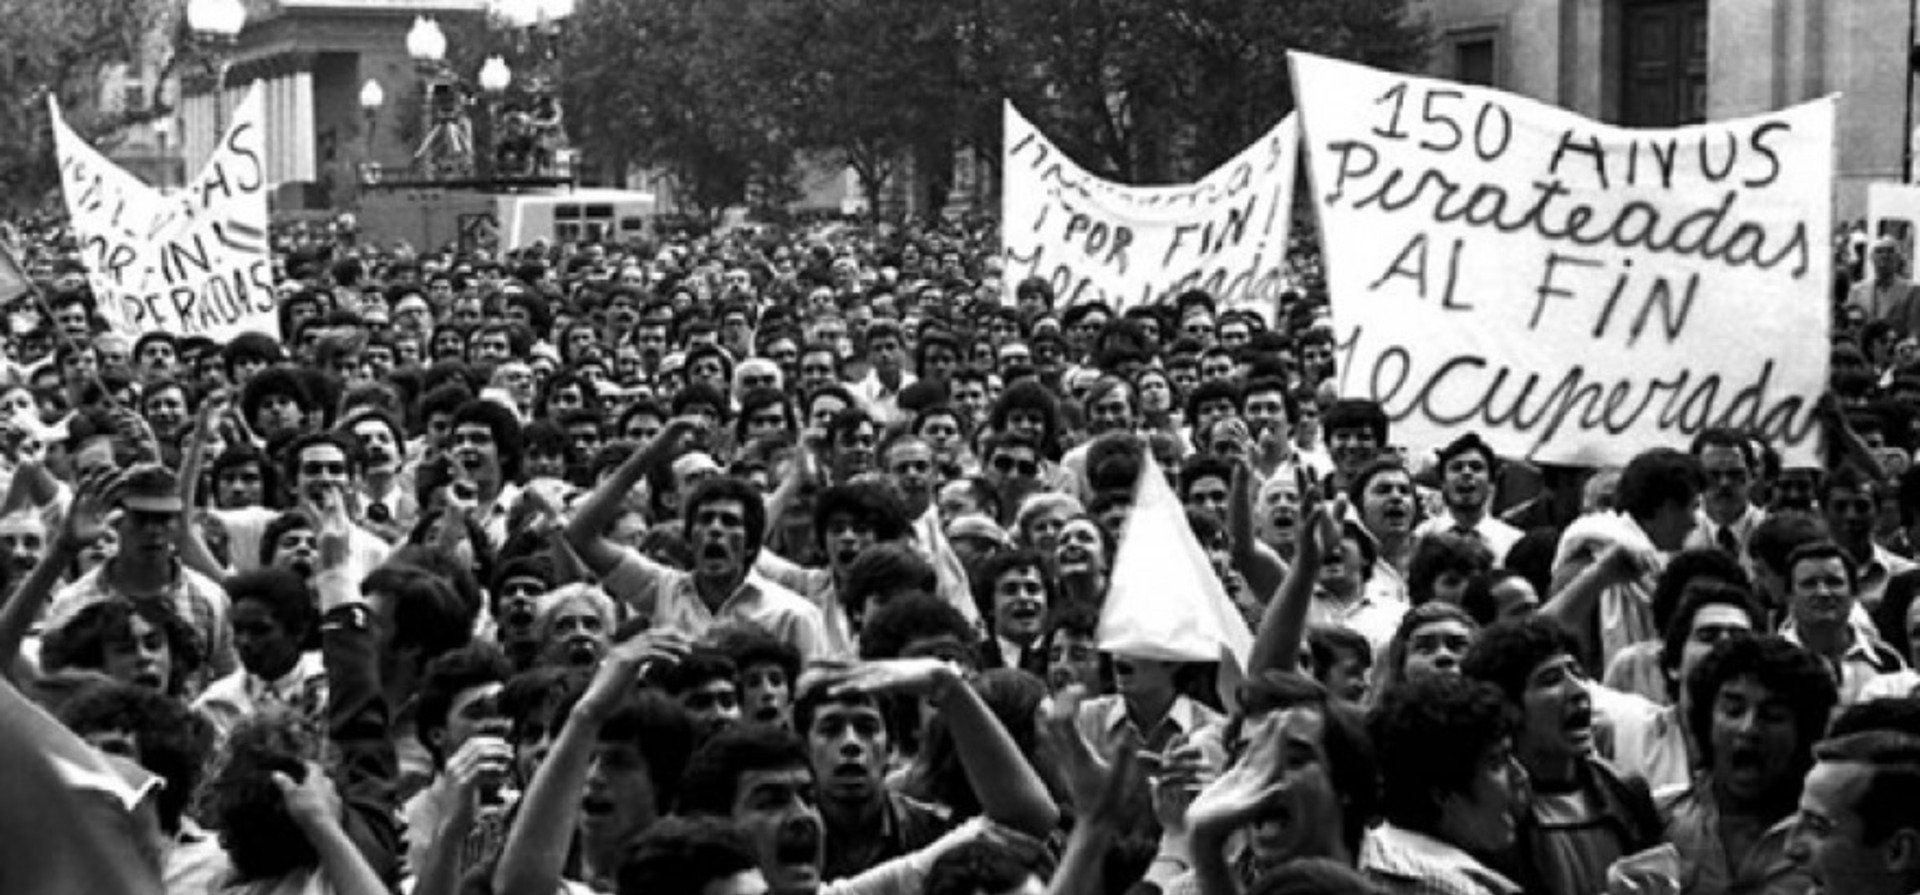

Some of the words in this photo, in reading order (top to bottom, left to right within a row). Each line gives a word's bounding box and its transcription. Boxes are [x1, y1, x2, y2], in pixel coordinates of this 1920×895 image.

[1372, 82, 1513, 161] 150
[1324, 140, 1810, 280] Pirateadas
[1368, 232, 1474, 312] AL
